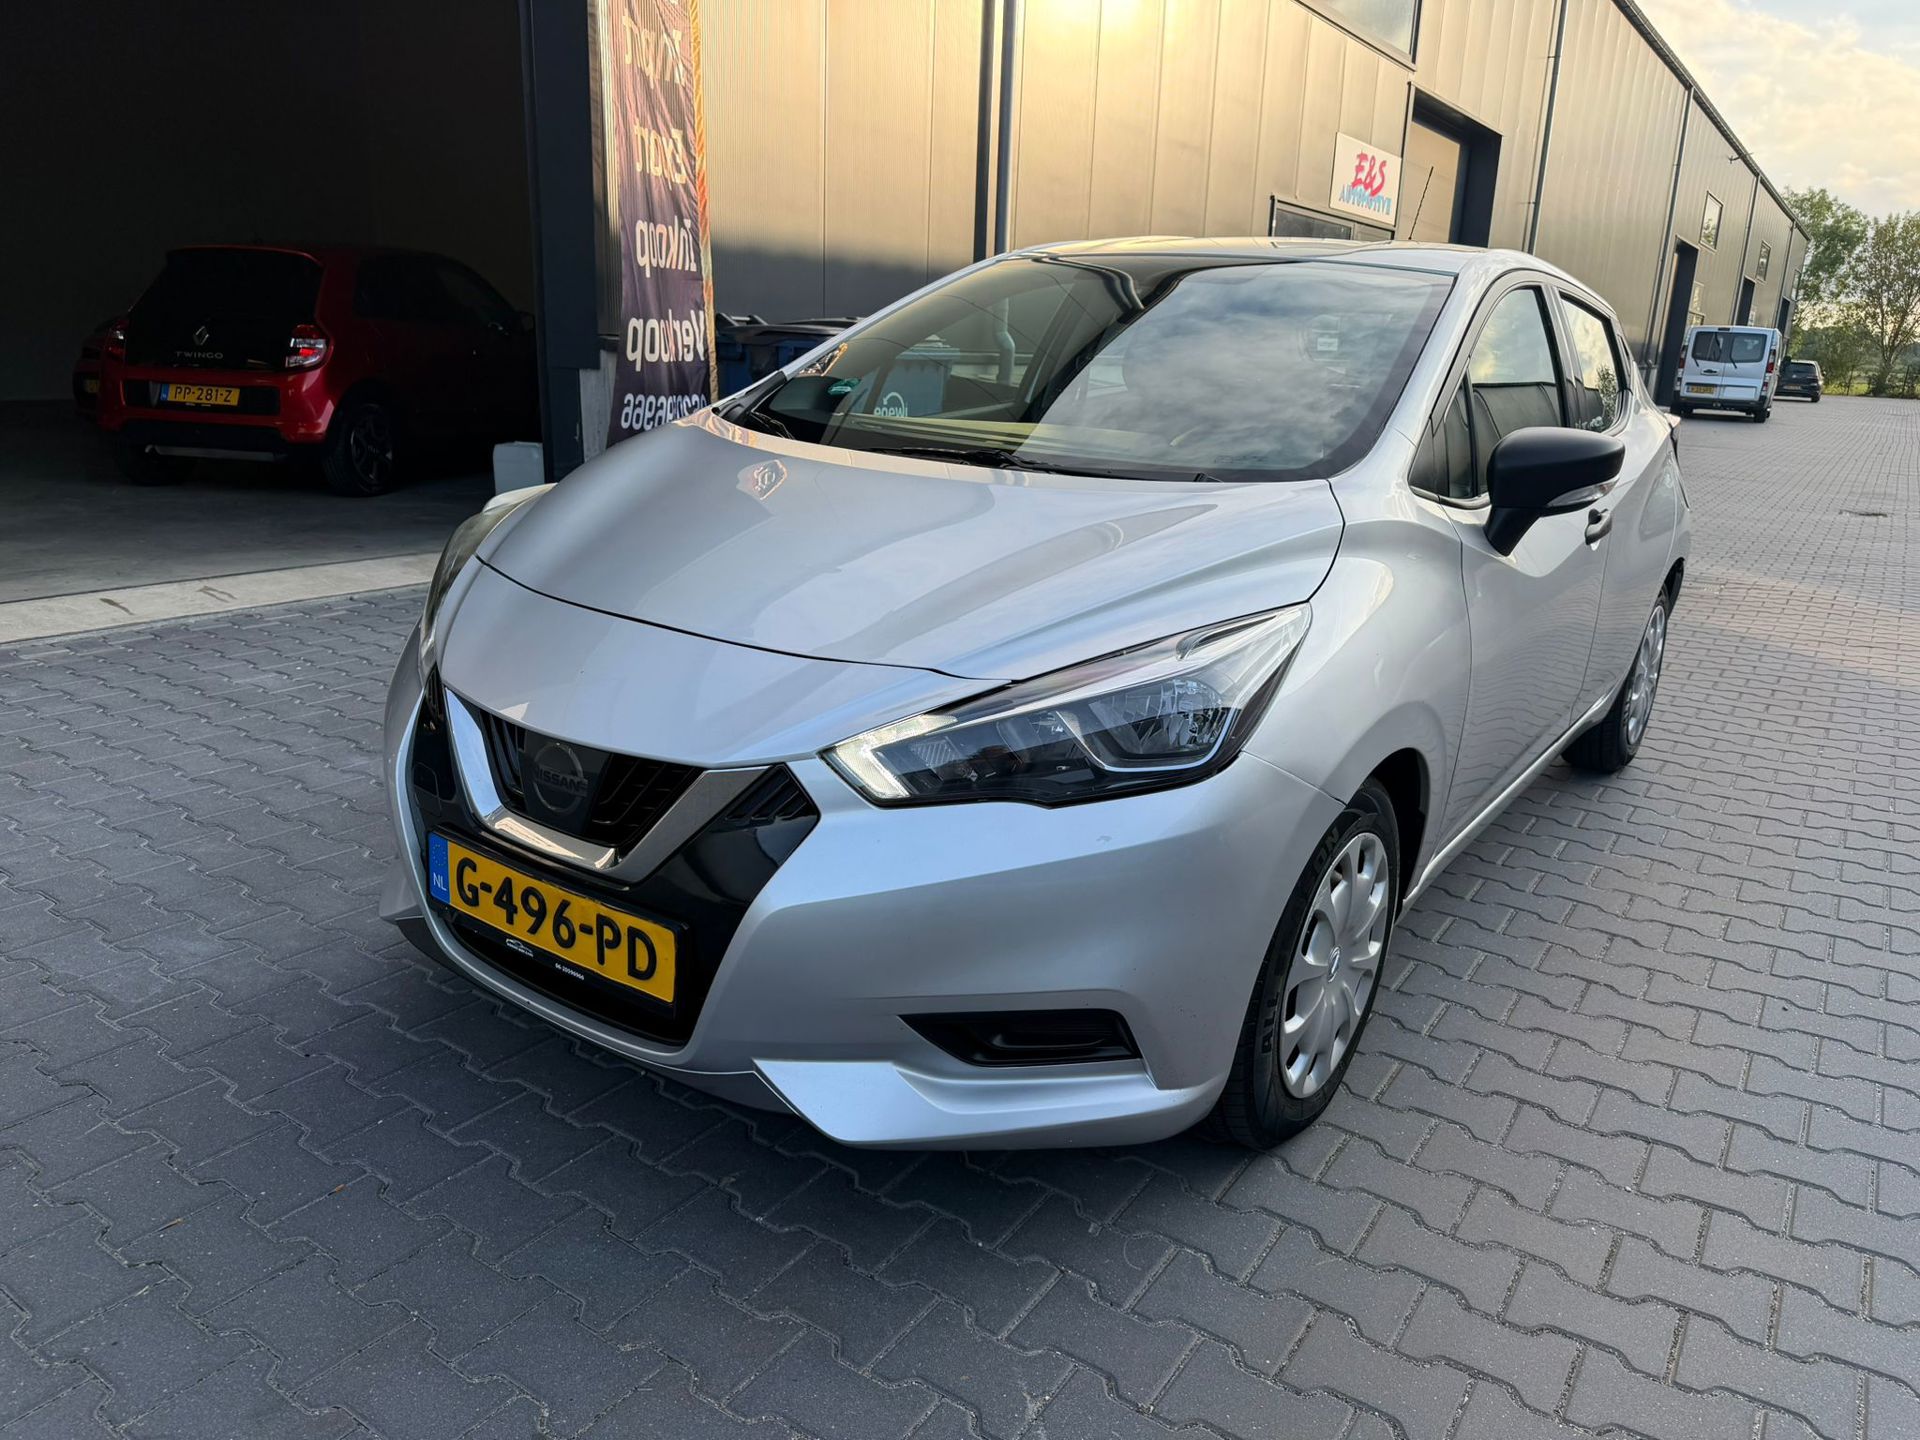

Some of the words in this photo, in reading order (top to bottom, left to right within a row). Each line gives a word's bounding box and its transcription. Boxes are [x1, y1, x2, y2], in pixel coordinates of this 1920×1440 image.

[1351, 152, 1388, 198] E&S
[174, 350, 225, 360] TWINGO
[174, 385, 234, 403] PP-281-Z
[432, 872, 447, 892] NL
[455, 856, 658, 982] G-496-PD
